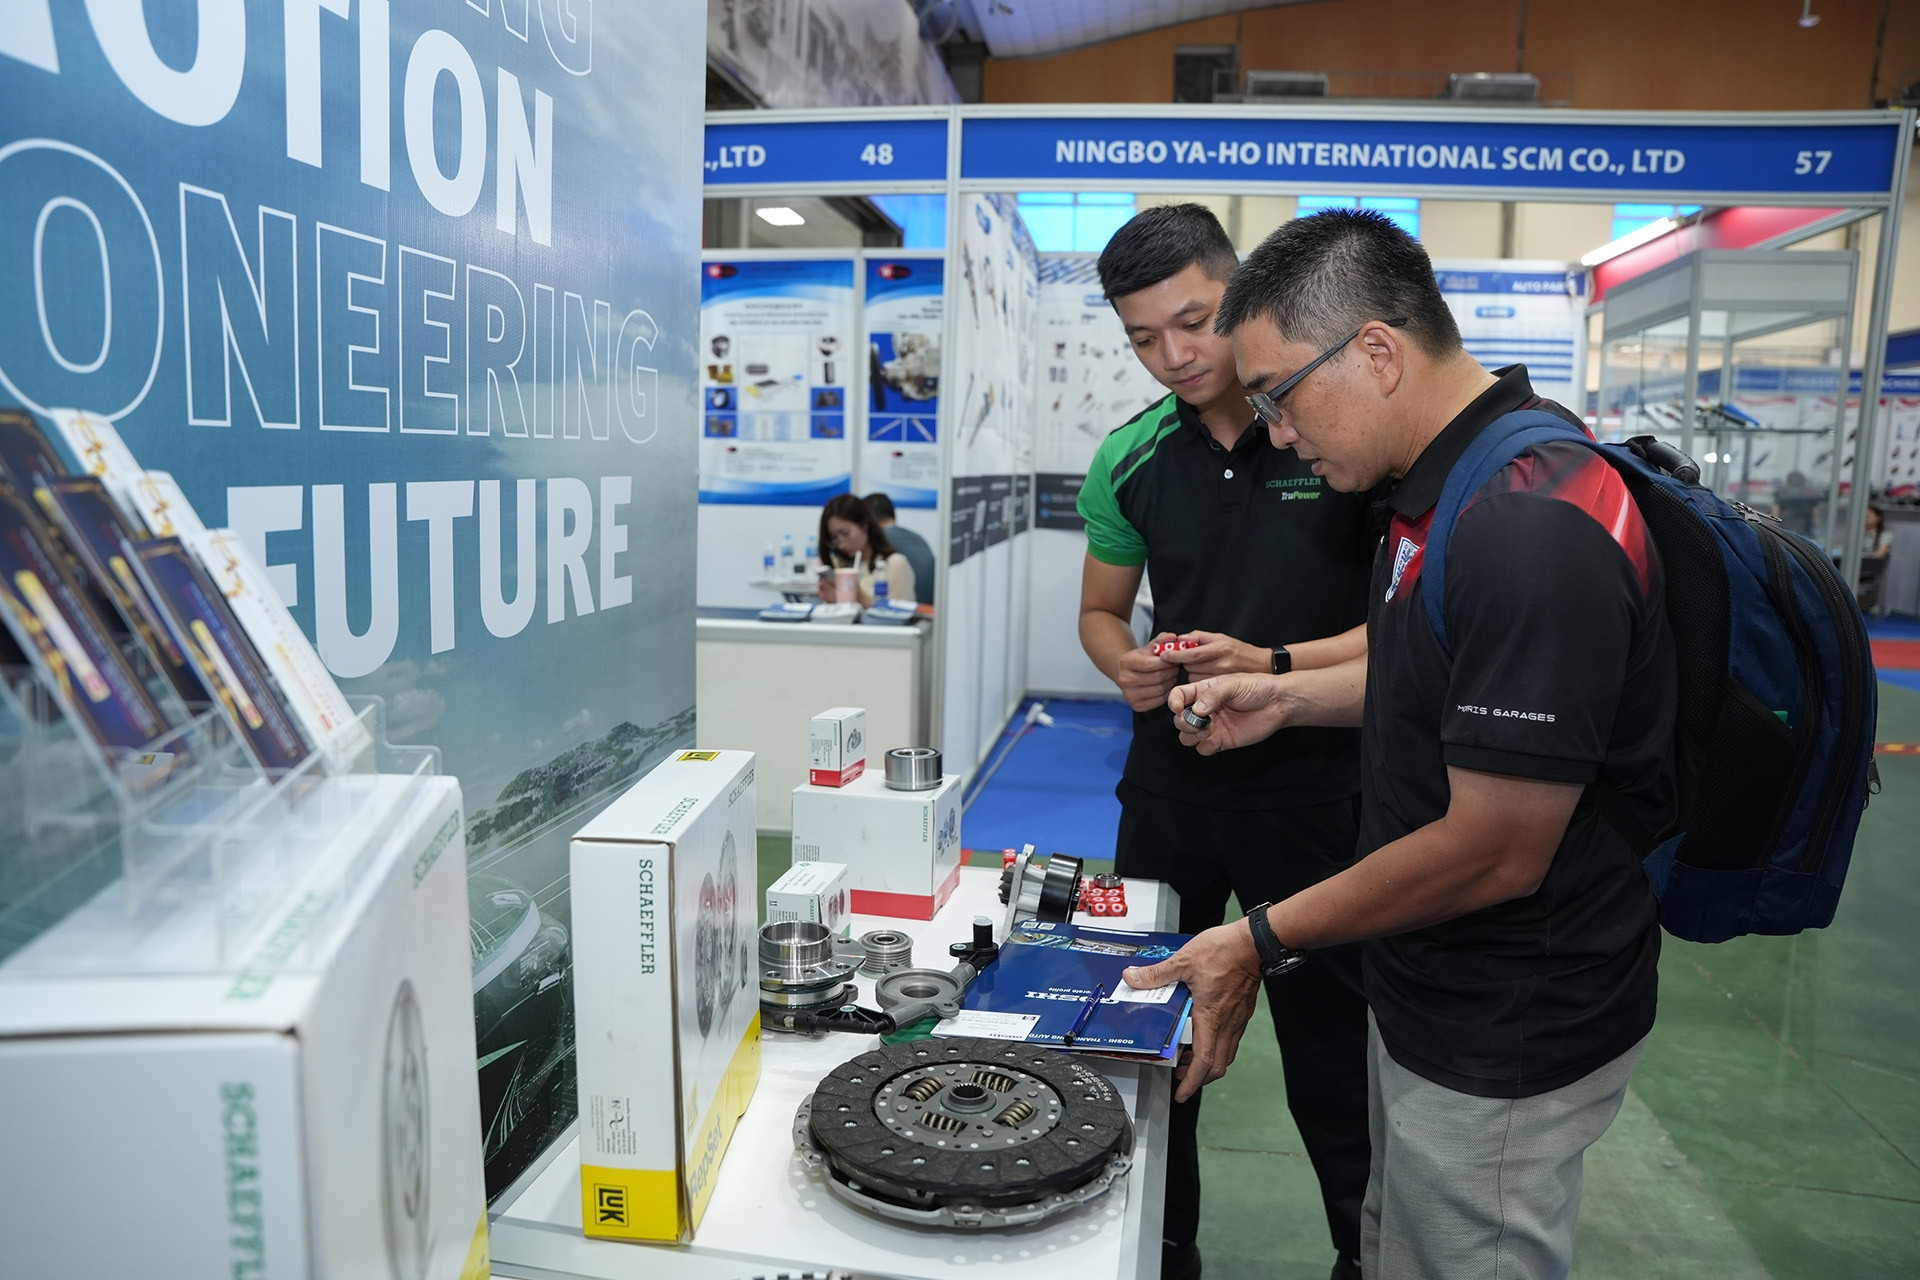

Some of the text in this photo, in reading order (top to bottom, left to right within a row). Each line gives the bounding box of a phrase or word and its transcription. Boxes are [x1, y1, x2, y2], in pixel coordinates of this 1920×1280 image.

[861, 143, 894, 165] 48
[1055, 139, 1833, 176] NINGBO YA-HO INTERNATIONAL SCM CO., LTD 57
[0, 138, 659, 445] ONEERING
[1265, 477, 1321, 488] SCHAEFFLER
[1281, 491, 1321, 500] TruPower
[228, 475, 633, 679] FUTURE
[1493, 708, 1556, 722] GARAGES
[638, 858, 655, 975] SCHAEFFLER
